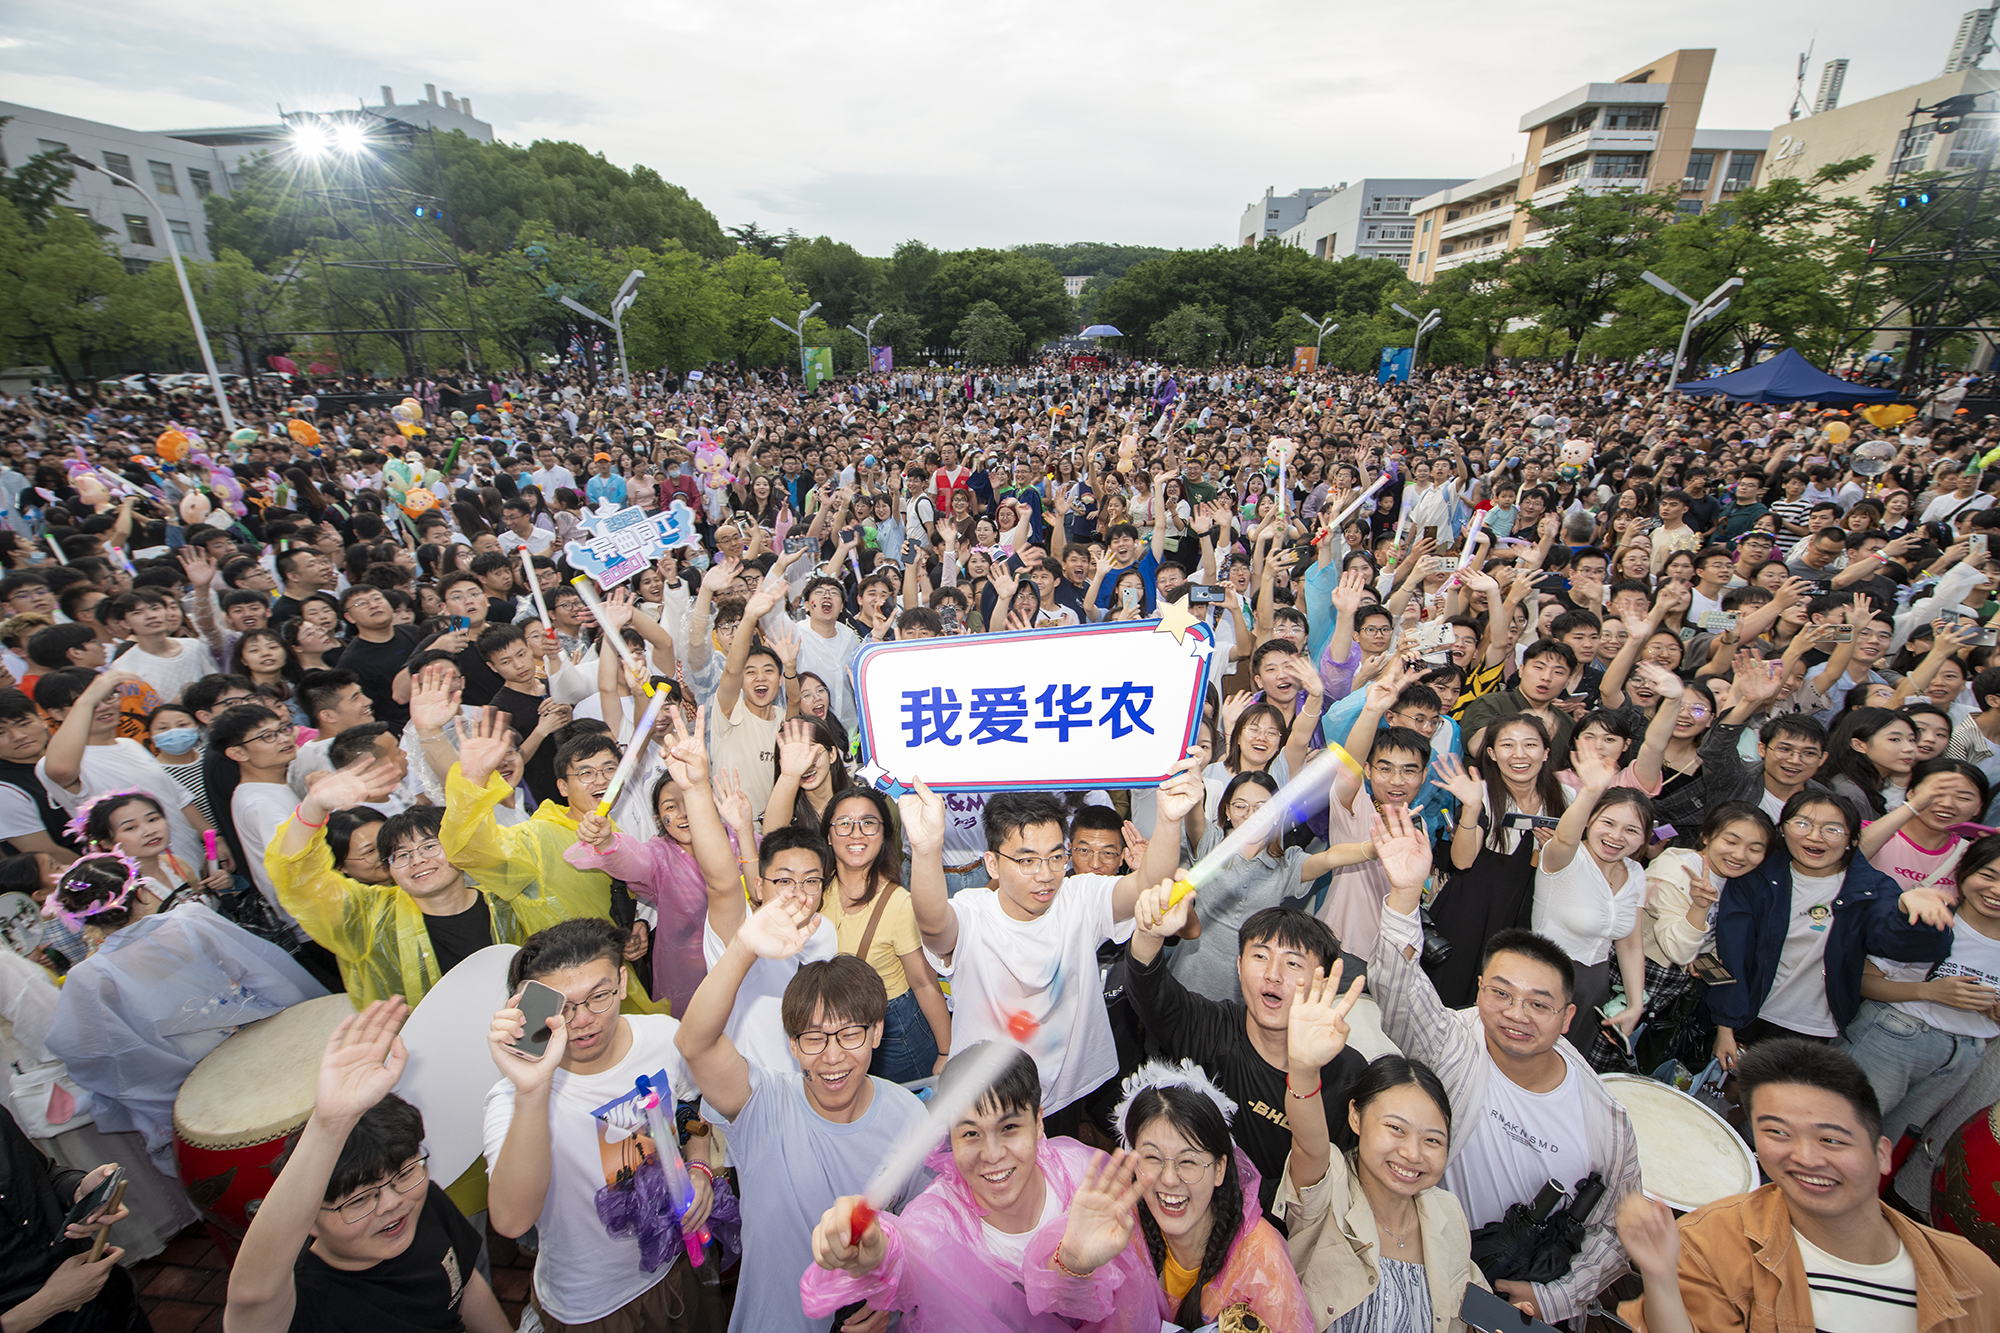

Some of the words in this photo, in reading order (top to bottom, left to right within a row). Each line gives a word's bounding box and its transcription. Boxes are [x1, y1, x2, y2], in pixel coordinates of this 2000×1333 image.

[588, 513, 681, 562] 异曲同工
[598, 551, 648, 587] GOGO!
[900, 681, 1155, 748] 我爱华农
[1939, 967, 1957, 975] OOD
[1960, 965, 1984, 977] THINGS
[1985, 973, 1999, 983] ARE
